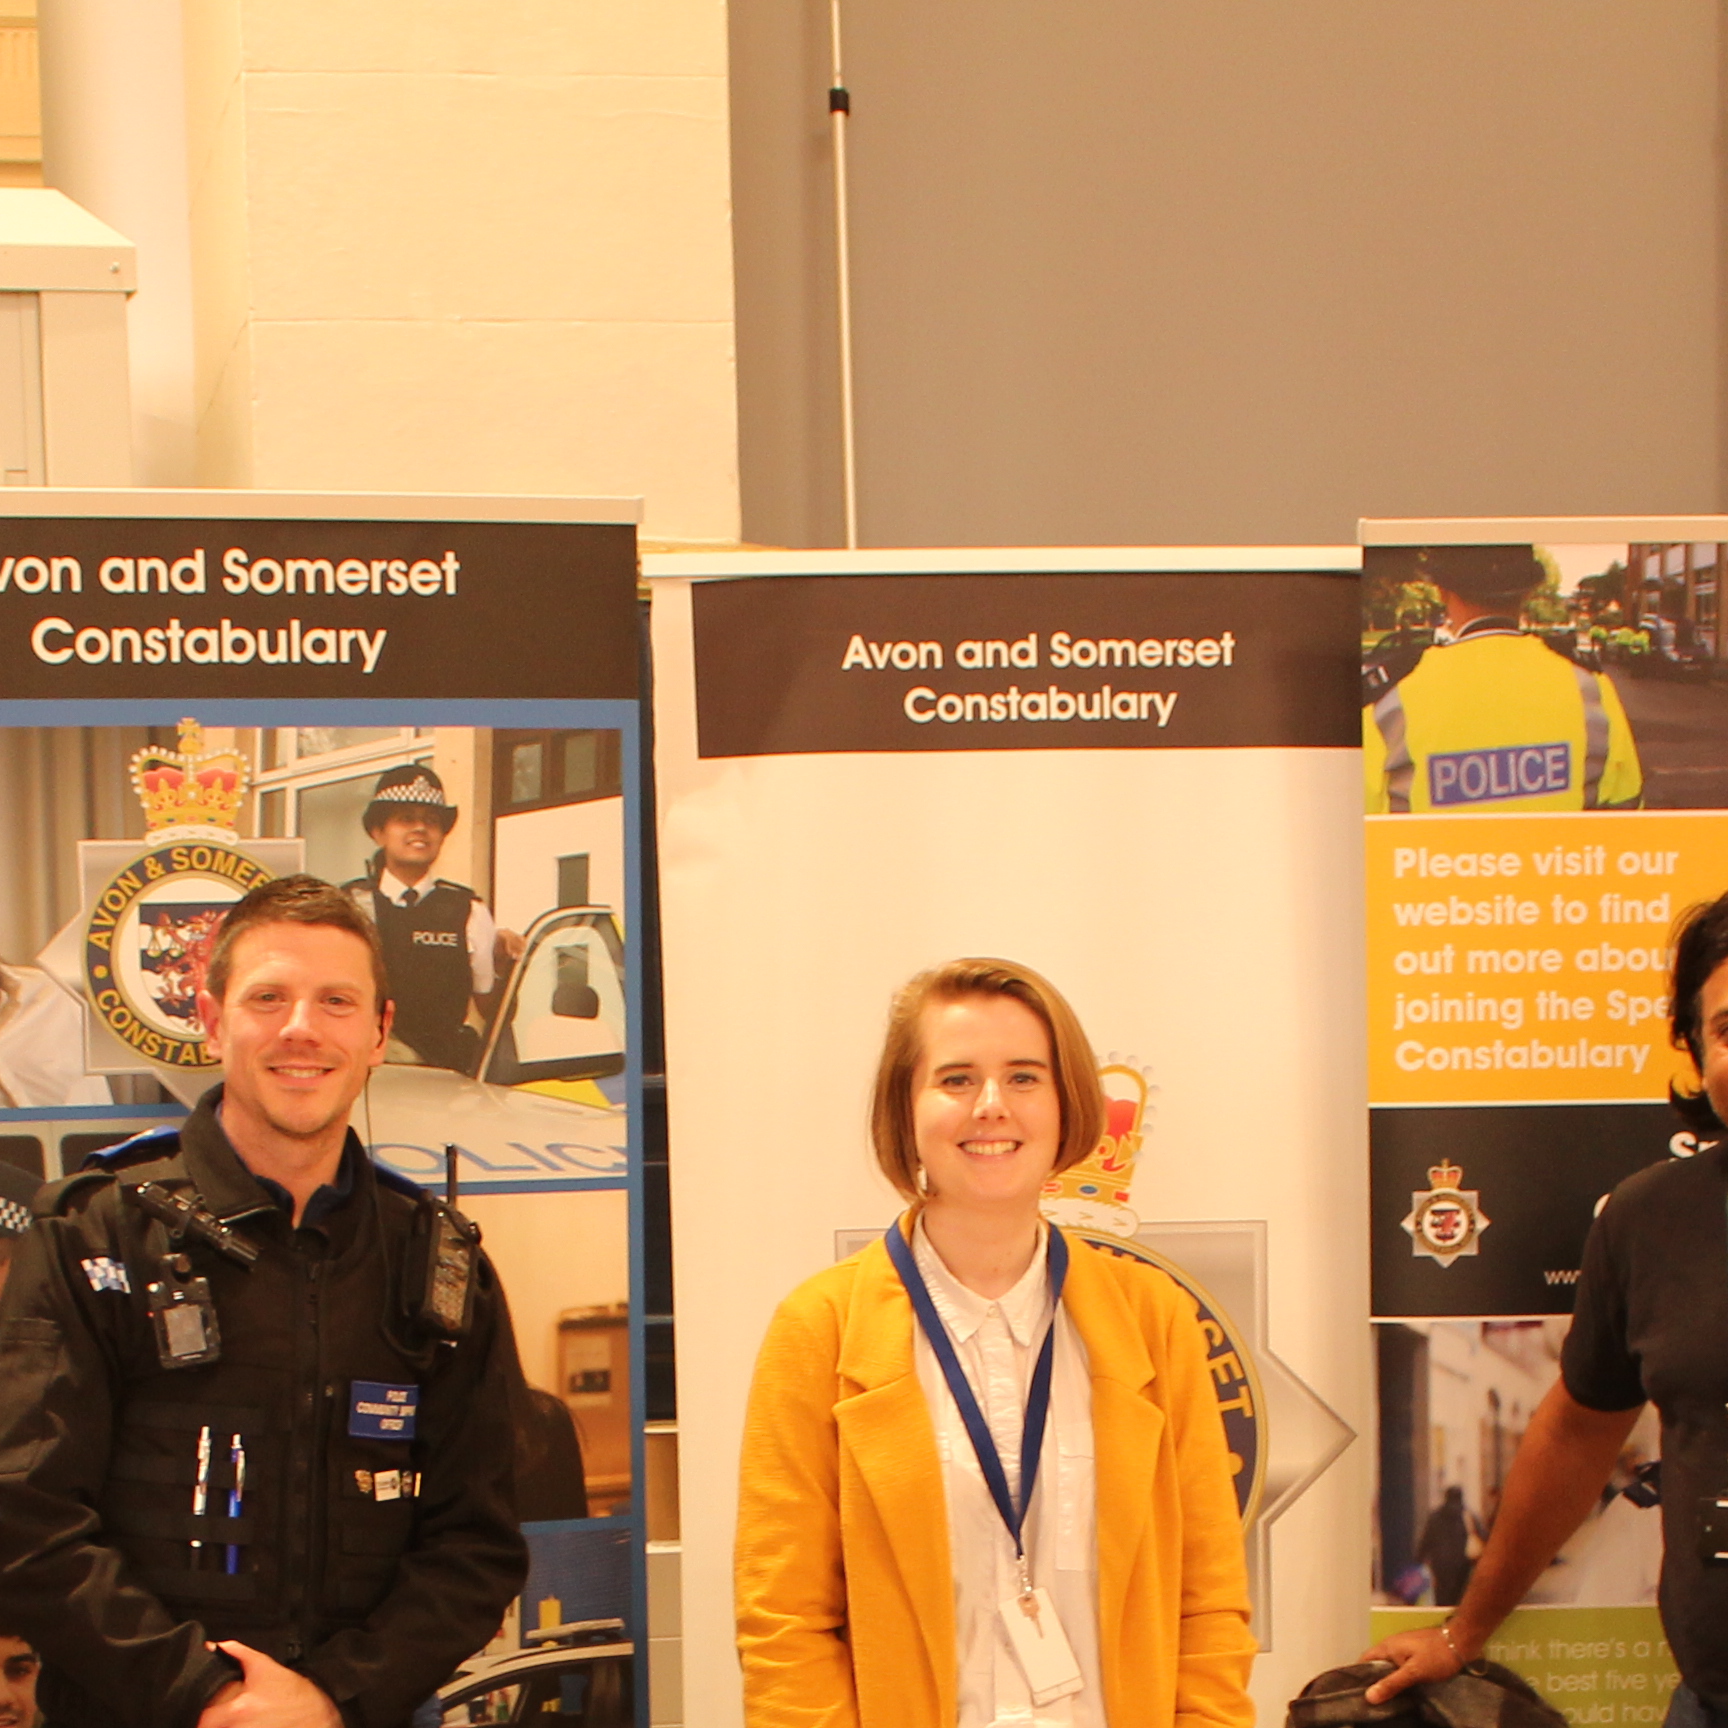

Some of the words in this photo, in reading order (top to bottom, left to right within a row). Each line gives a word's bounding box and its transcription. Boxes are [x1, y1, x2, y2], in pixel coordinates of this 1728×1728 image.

[100, 546, 207, 595] and
[221, 547, 461, 597] Somerset
[31, 617, 387, 675] Constabulary
[841, 634, 944, 671] Avon
[955, 632, 1039, 670] and
[1049, 630, 1236, 668] Somerset
[903, 686, 1177, 727] Constabulary
[1433, 747, 1567, 801] POLICE
[1393, 847, 1522, 879] Please
[1532, 845, 1607, 876] visit
[1617, 850, 1680, 876] our
[87, 870, 144, 951] AVON
[1393, 894, 1541, 927] website
[1551, 894, 1589, 925] to
[1599, 892, 1671, 924] find
[412, 930, 459, 948] POLICE
[1393, 943, 1455, 976] out
[1467, 948, 1564, 974] more
[1393, 992, 1523, 1031] joining
[1536, 991, 1595, 1022] the
[1394, 1037, 1652, 1075] Constabulary
